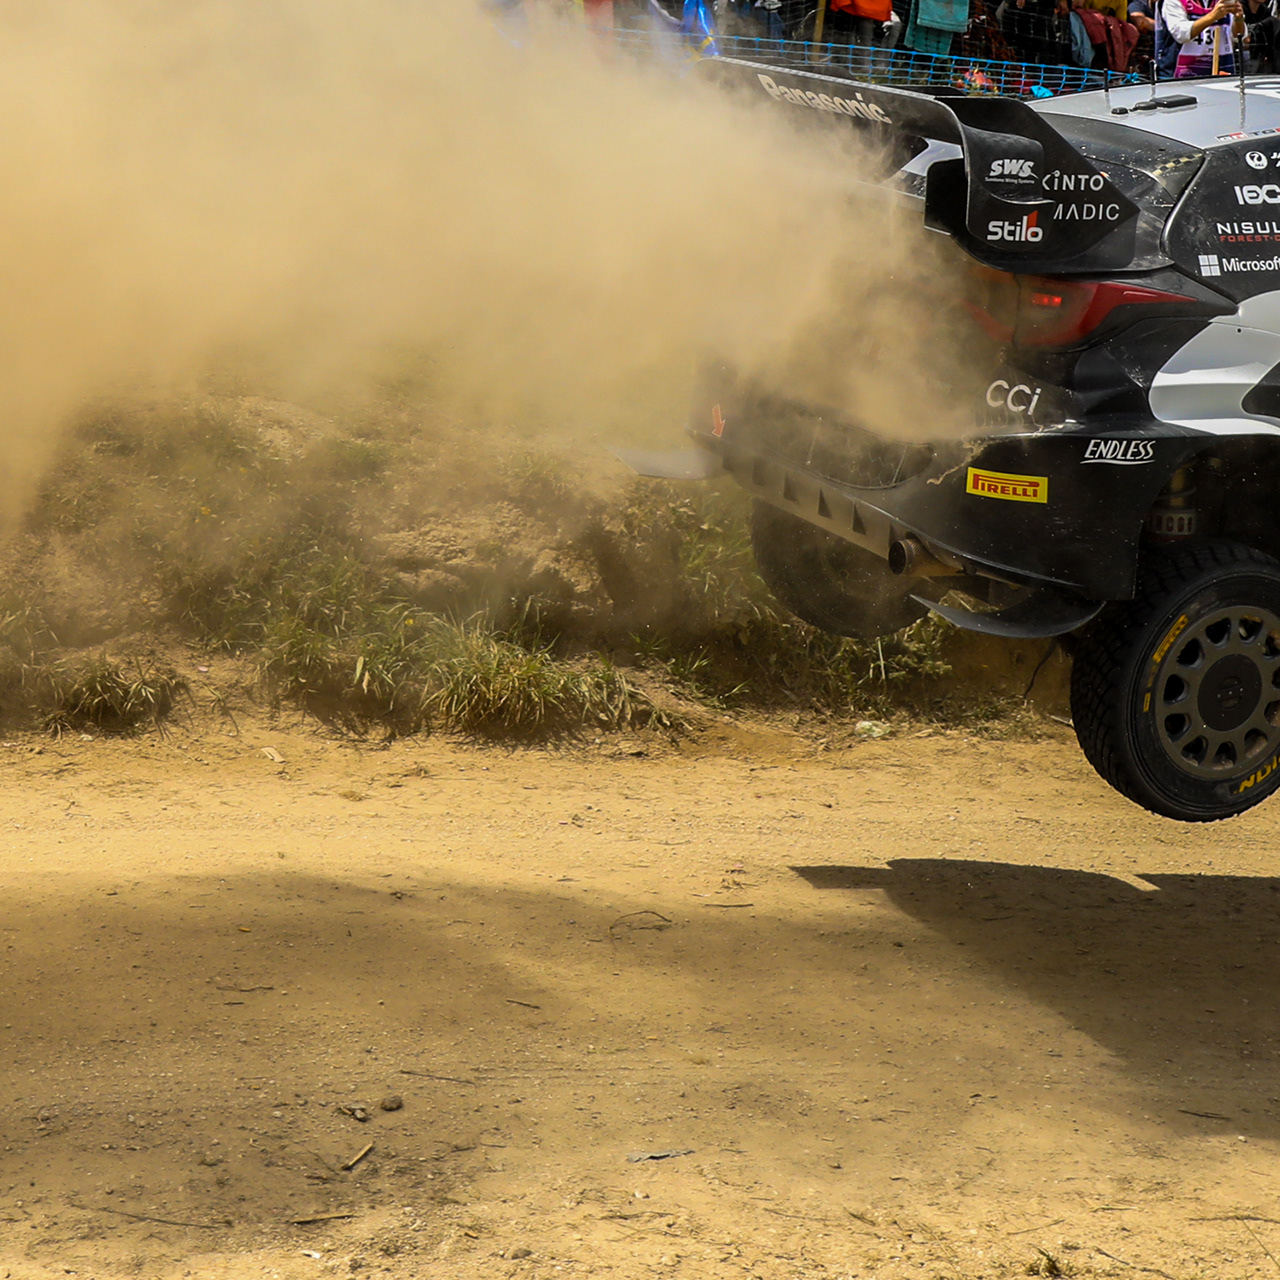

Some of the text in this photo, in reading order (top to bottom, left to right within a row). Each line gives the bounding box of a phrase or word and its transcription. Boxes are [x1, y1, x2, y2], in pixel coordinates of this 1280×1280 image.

[1193, 28, 1216, 46] 43
[757, 73, 892, 124] Panasonic
[987, 213, 1043, 243] Stilo
[1084, 439, 1156, 460] ENDLESS
[972, 473, 1041, 498] PIRELLI
